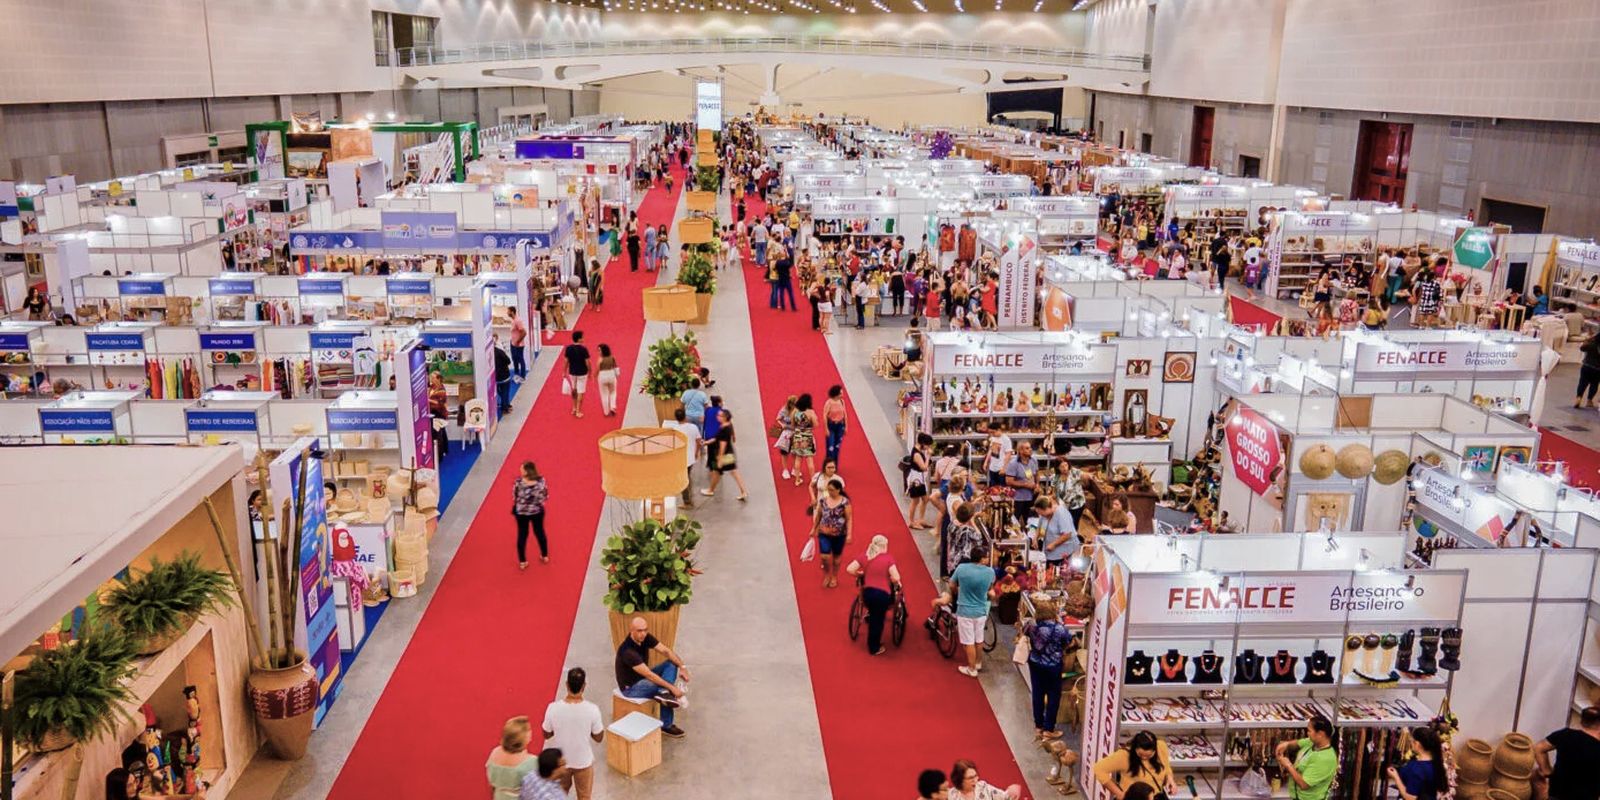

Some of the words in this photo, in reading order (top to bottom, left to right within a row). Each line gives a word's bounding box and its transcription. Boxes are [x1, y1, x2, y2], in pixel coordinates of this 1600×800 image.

[1004, 262, 1013, 318] PERNAMBUCO
[1021, 291, 1029, 324] DISTRITO
[954, 353, 1024, 367] FENACCE
[1377, 351, 1448, 365] FENACCE
[1466, 350, 1518, 359] Artesanato
[1465, 358, 1507, 366] Brasileiro
[1242, 416, 1267, 443] MATO
[1236, 432, 1270, 465] GROSSO
[1236, 450, 1249, 470] DO
[1250, 460, 1266, 483] SUL
[1168, 587, 1296, 609] FENACCE
[1330, 585, 1425, 598] Artesanao
[1330, 598, 1405, 611] Brasileiro
[1094, 618, 1102, 646] SUL
[1092, 650, 1099, 675] DO
[1087, 679, 1097, 742] GROSSO
[1084, 743, 1094, 789] MATO
